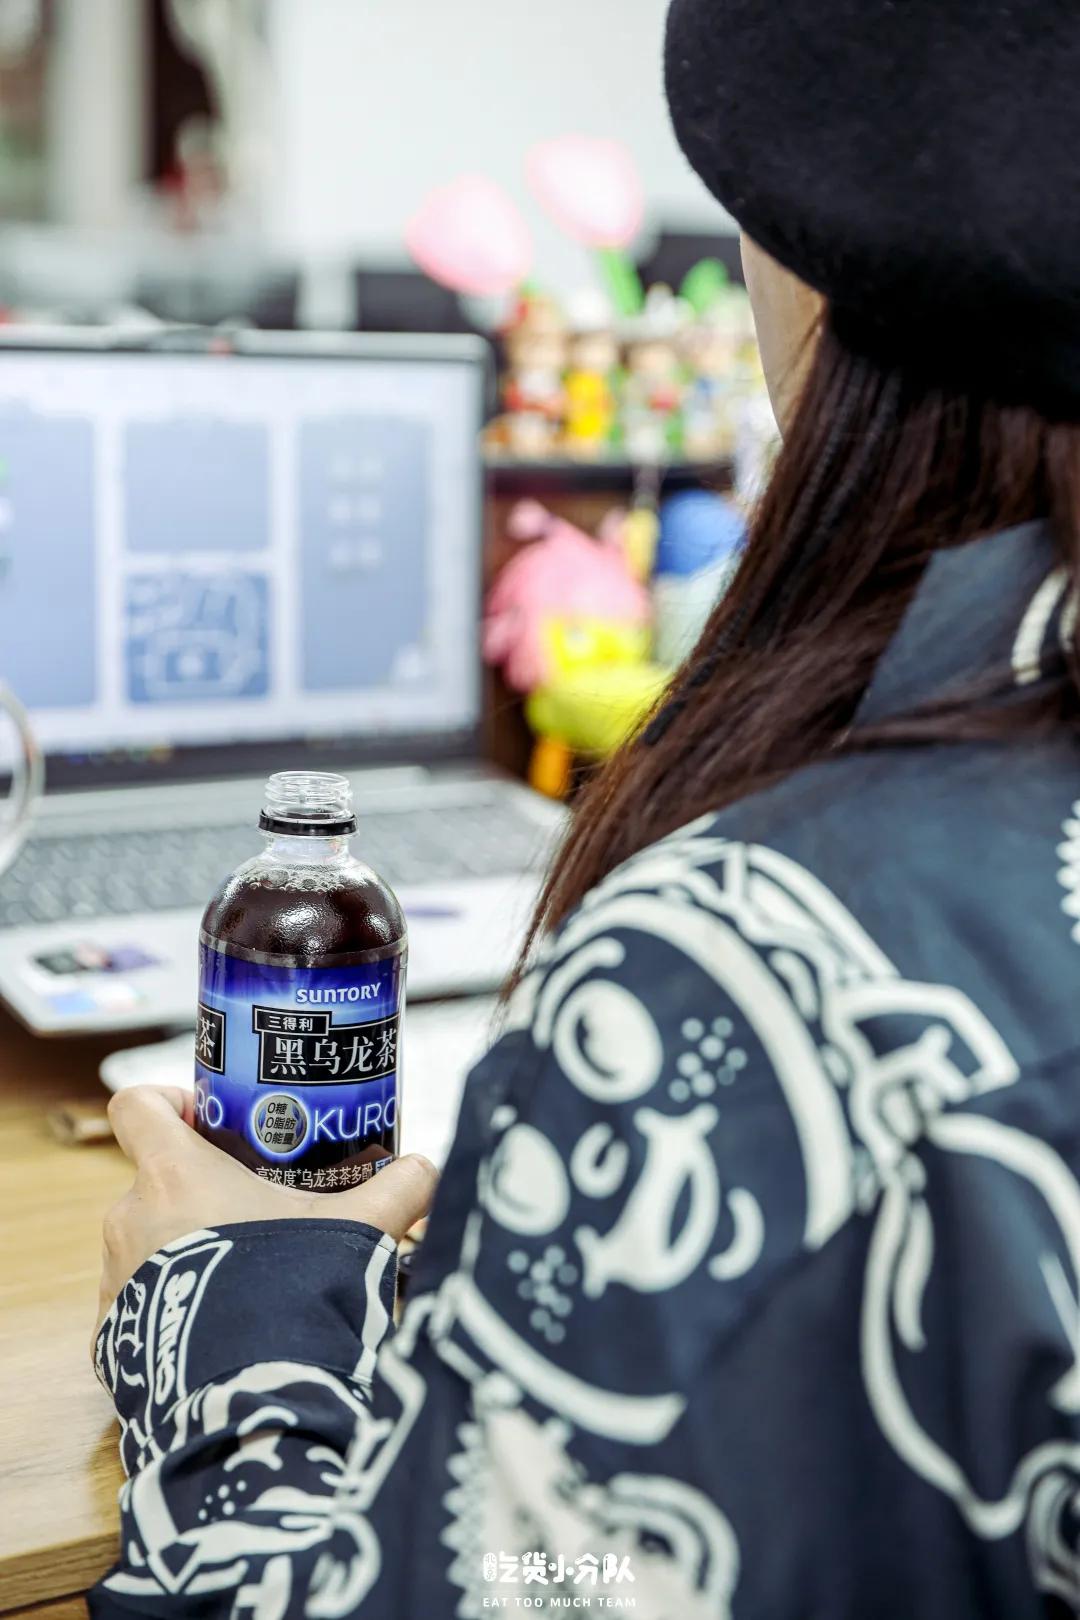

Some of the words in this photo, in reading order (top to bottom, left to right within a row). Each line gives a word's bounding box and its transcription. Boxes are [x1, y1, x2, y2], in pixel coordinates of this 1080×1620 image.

[296, 982, 382, 1004] SUNTORY
[267, 1016, 313, 1031] 三得利
[270, 1028, 397, 1076] 黑乌龙茶
[267, 1102, 289, 1115] 0糖
[265, 1117, 297, 1130] 0脂肪
[263, 1132, 295, 1146] 0能量
